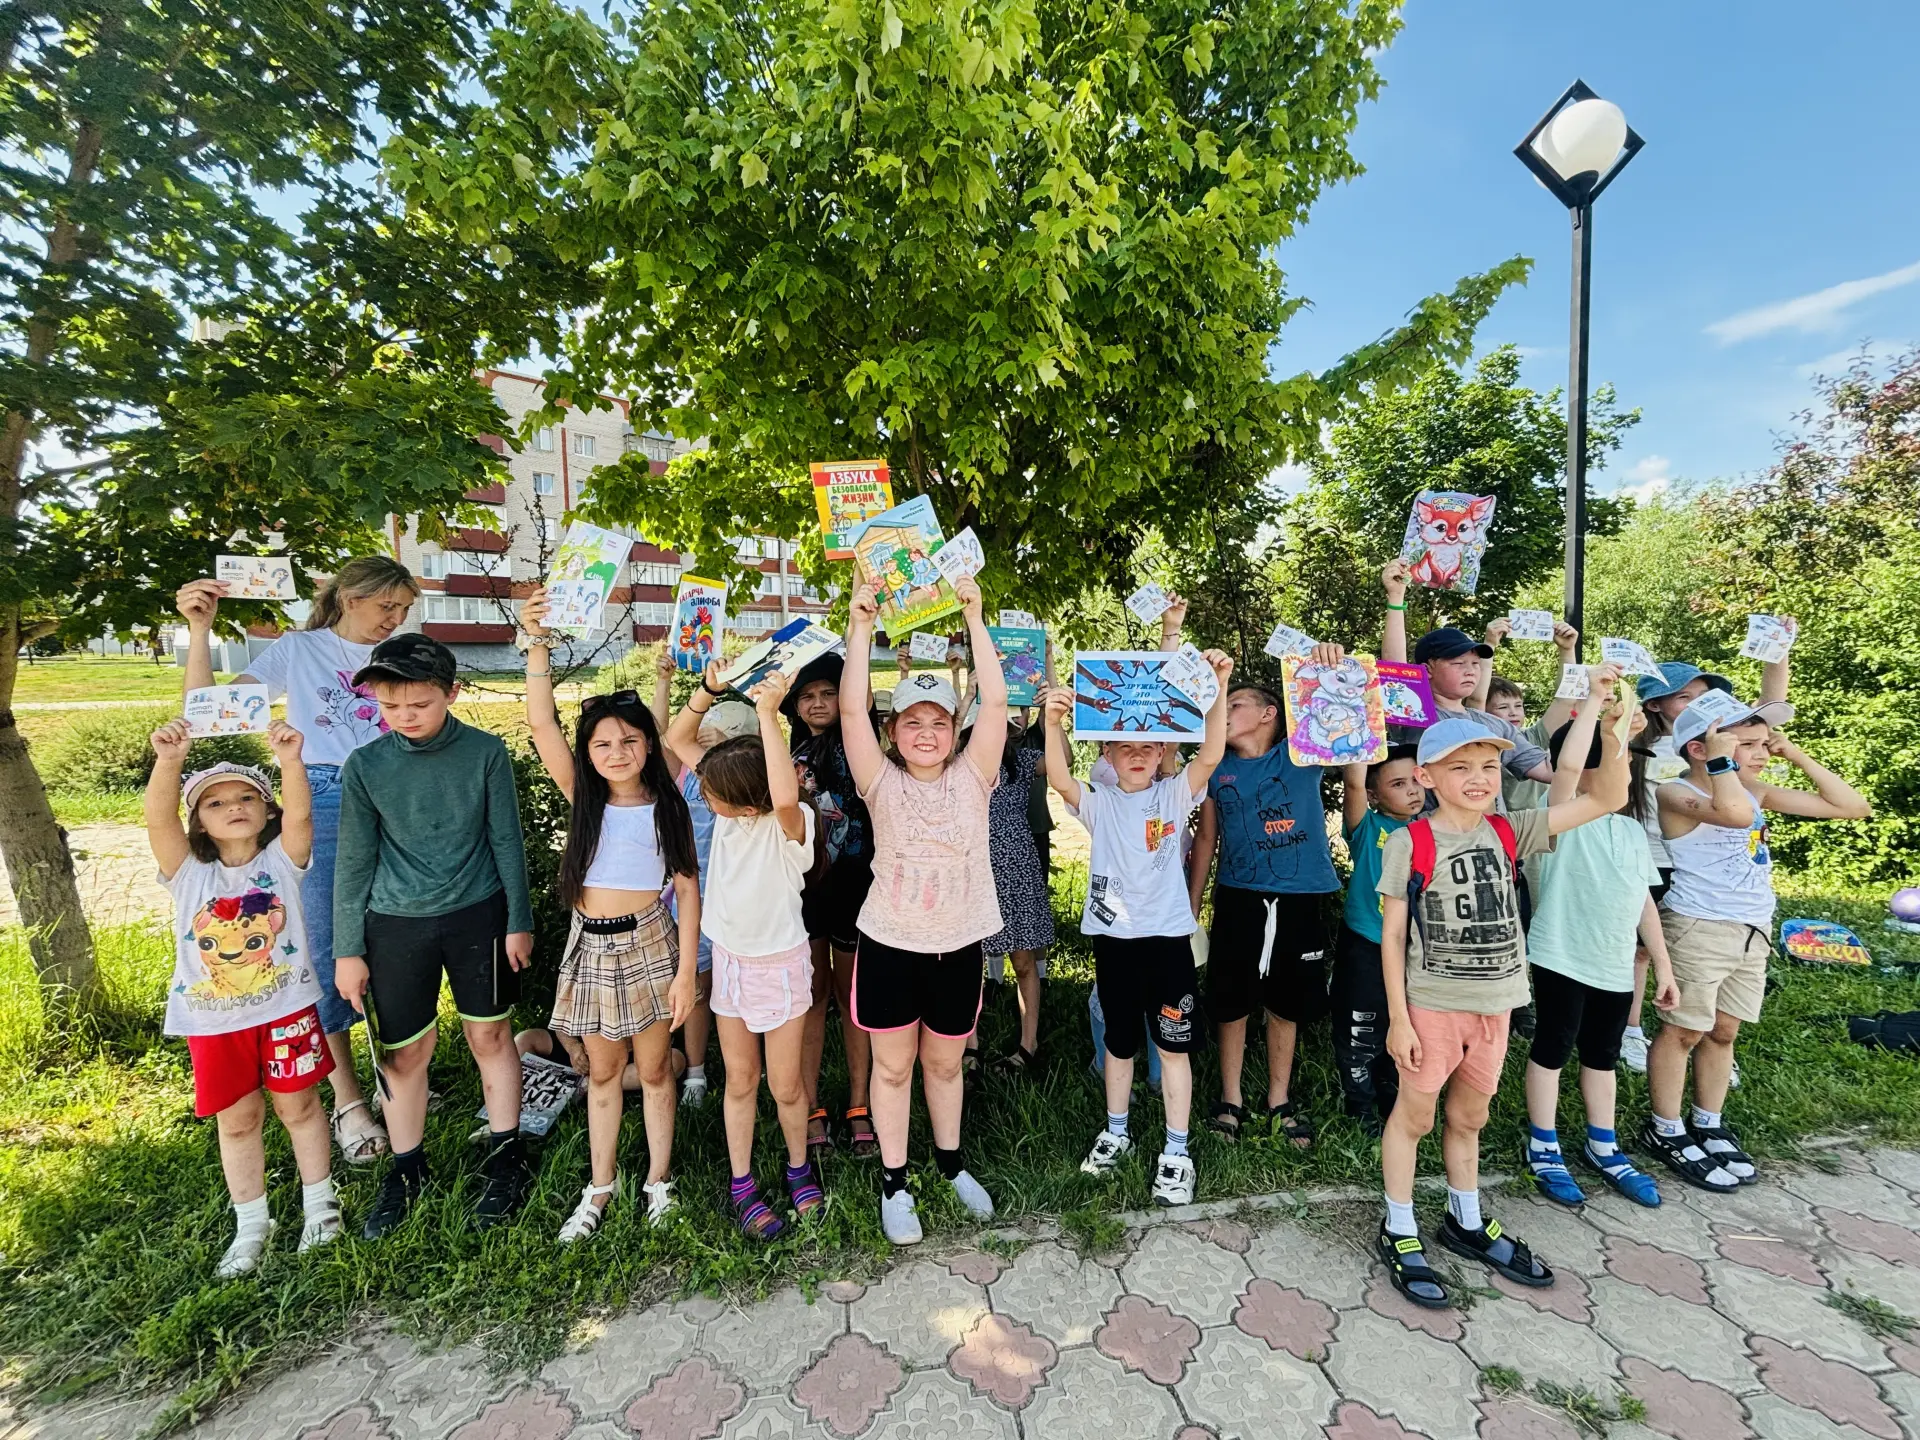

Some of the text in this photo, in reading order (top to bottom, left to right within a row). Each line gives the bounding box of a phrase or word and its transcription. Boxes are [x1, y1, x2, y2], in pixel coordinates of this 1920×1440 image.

[829, 471, 877, 485] АЗБУКА
[831, 483, 878, 494] БЕЗОПАСНОЙ
[841, 493, 875, 504] ЖИЗНИ
[690, 597, 721, 607] ӘЛИФБА
[1257, 802, 1293, 821] DON'T
[1264, 819, 1296, 837] STOP
[1255, 830, 1308, 852] ROLLING
[271, 1012, 317, 1042] LOVE
[275, 1041, 304, 1060] MY
